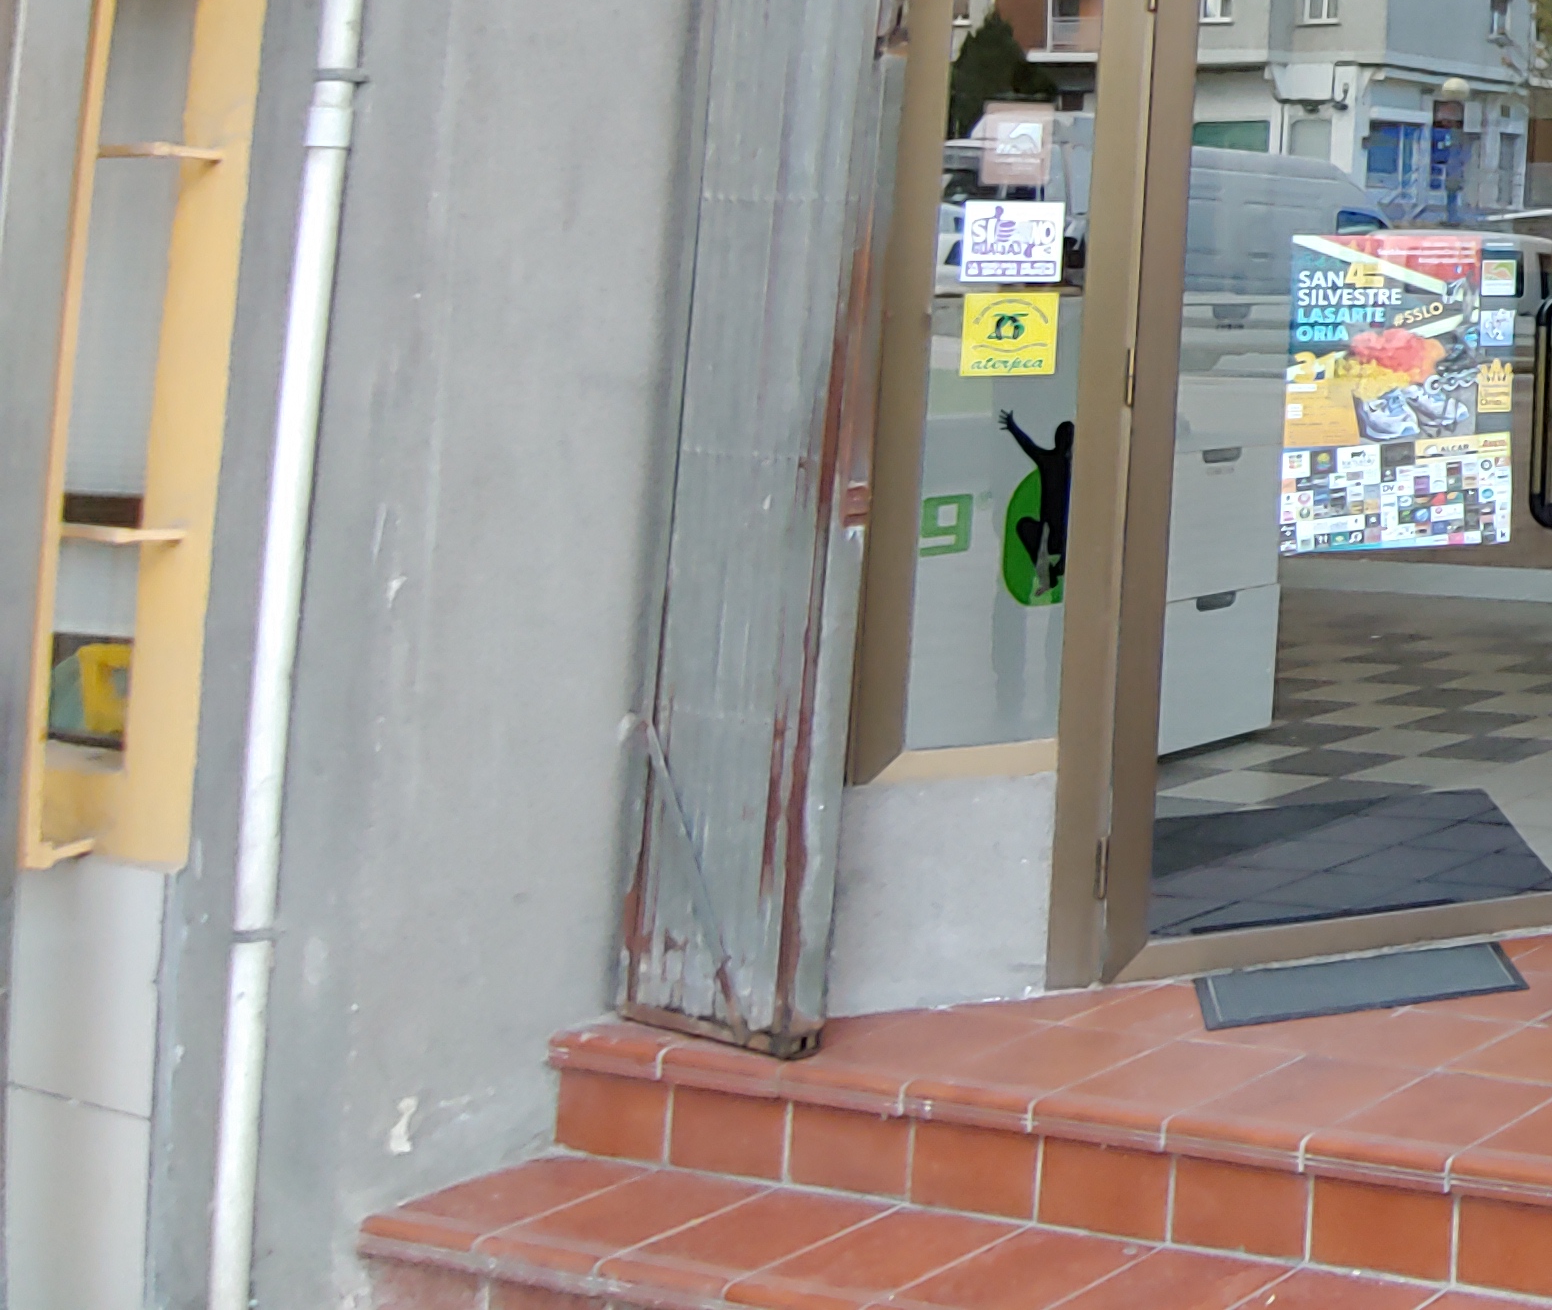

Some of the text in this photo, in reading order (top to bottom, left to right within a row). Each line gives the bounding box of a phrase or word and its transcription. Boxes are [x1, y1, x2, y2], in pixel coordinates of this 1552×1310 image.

[1298, 270, 1345, 288] SAN
[1297, 288, 1402, 307] SILVESTRE
[1297, 306, 1386, 324] LASARTE
[1393, 301, 1444, 327] #SSLO
[1296, 324, 1350, 342] ORIA
